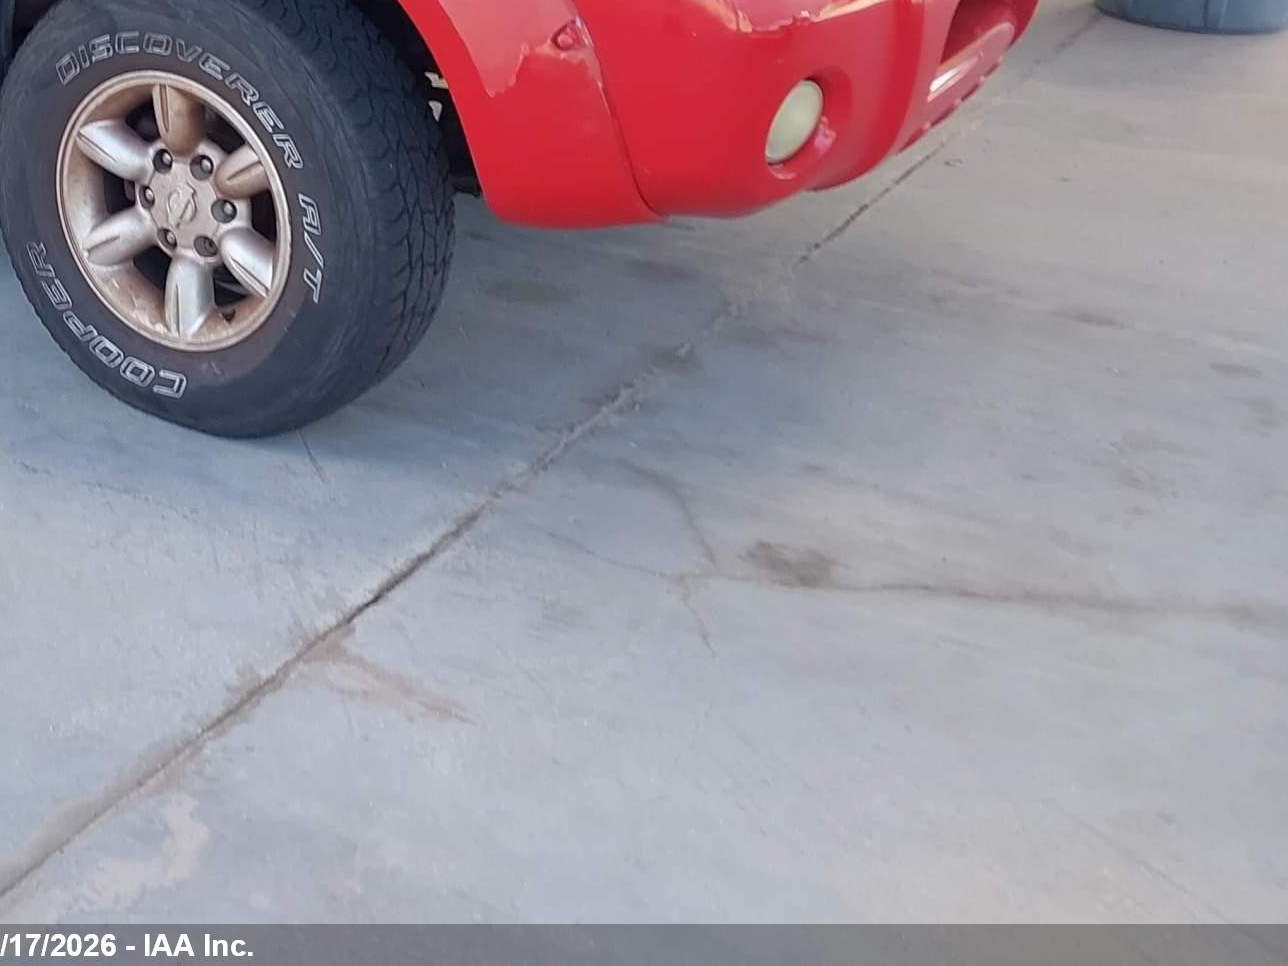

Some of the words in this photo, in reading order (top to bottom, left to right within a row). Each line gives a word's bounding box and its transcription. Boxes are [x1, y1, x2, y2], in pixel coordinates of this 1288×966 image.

[55, 30, 304, 170] DISCOVERER
[299, 194, 327, 304] A/T
[25, 241, 187, 400] COOPER
